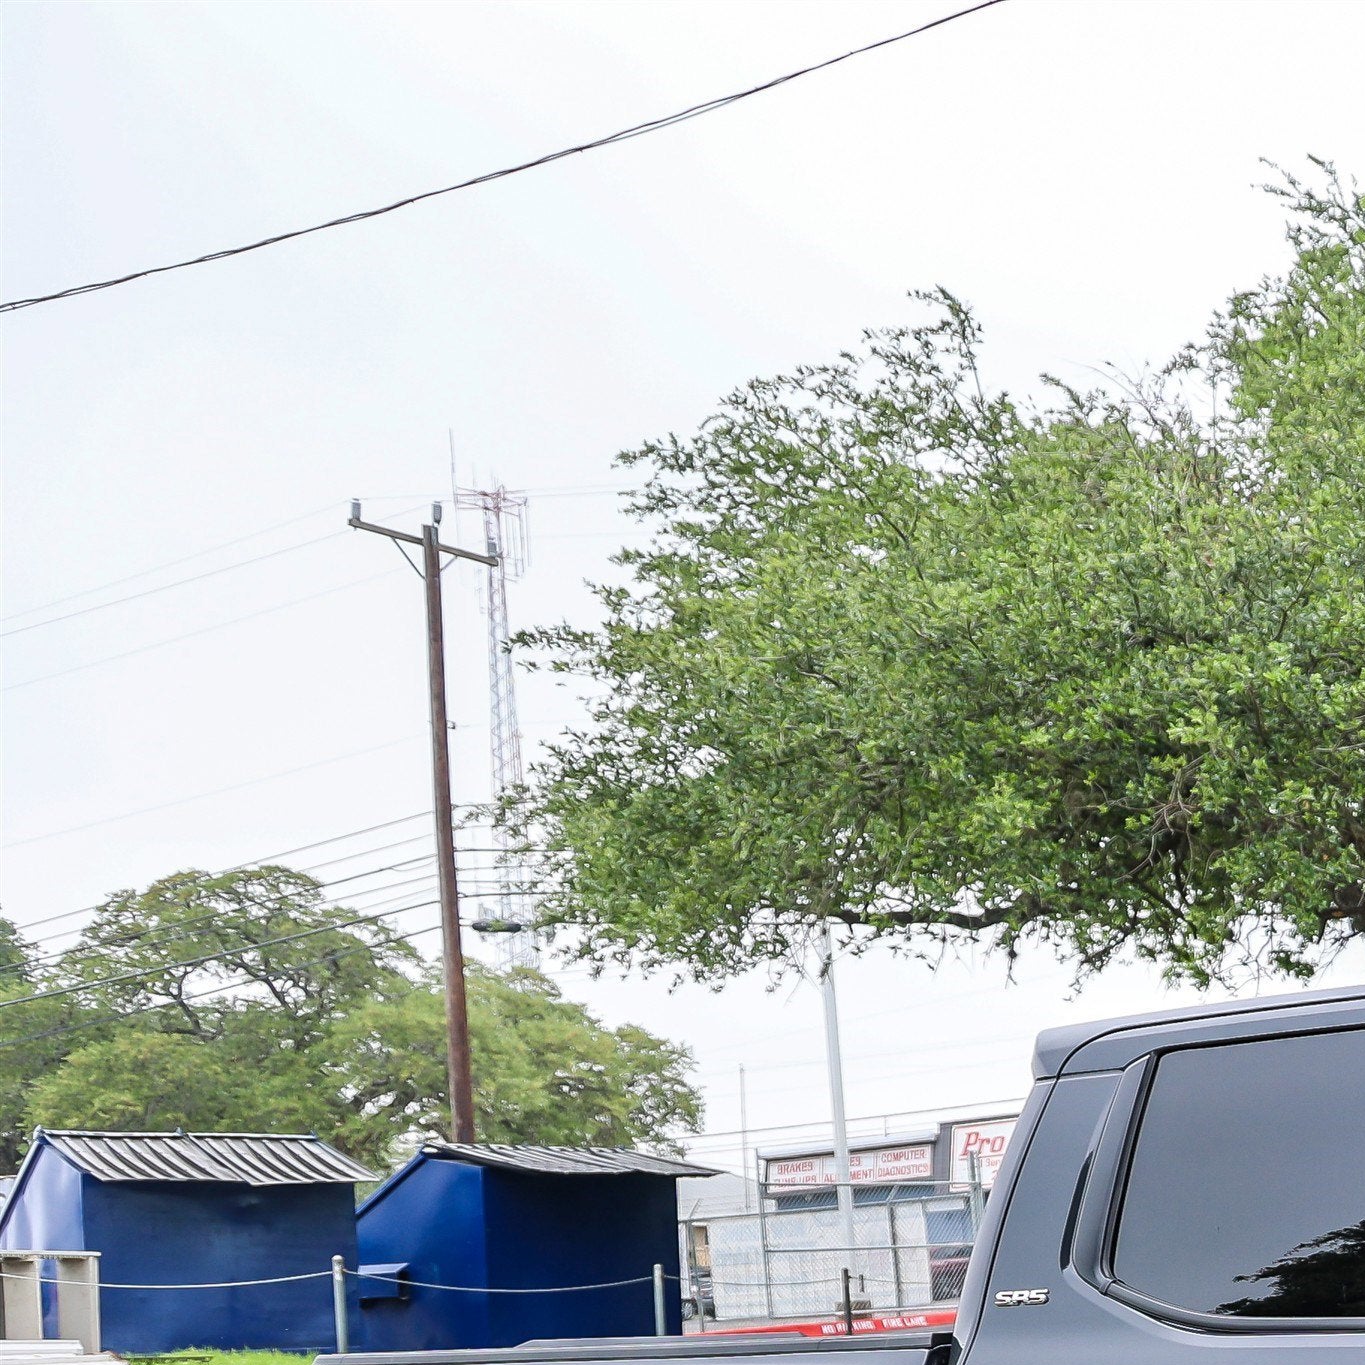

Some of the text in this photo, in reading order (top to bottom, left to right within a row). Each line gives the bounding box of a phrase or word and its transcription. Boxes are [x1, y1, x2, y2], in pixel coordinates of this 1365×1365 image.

[881, 1149, 925, 1163] COMPUTER
[777, 1161, 813, 1175] BRAKES
[877, 1163, 929, 1178] DIAGNOSTICS
[994, 1288, 1050, 1307] SR5
[821, 1315, 927, 1334] NO PAKING FIRE LANE
